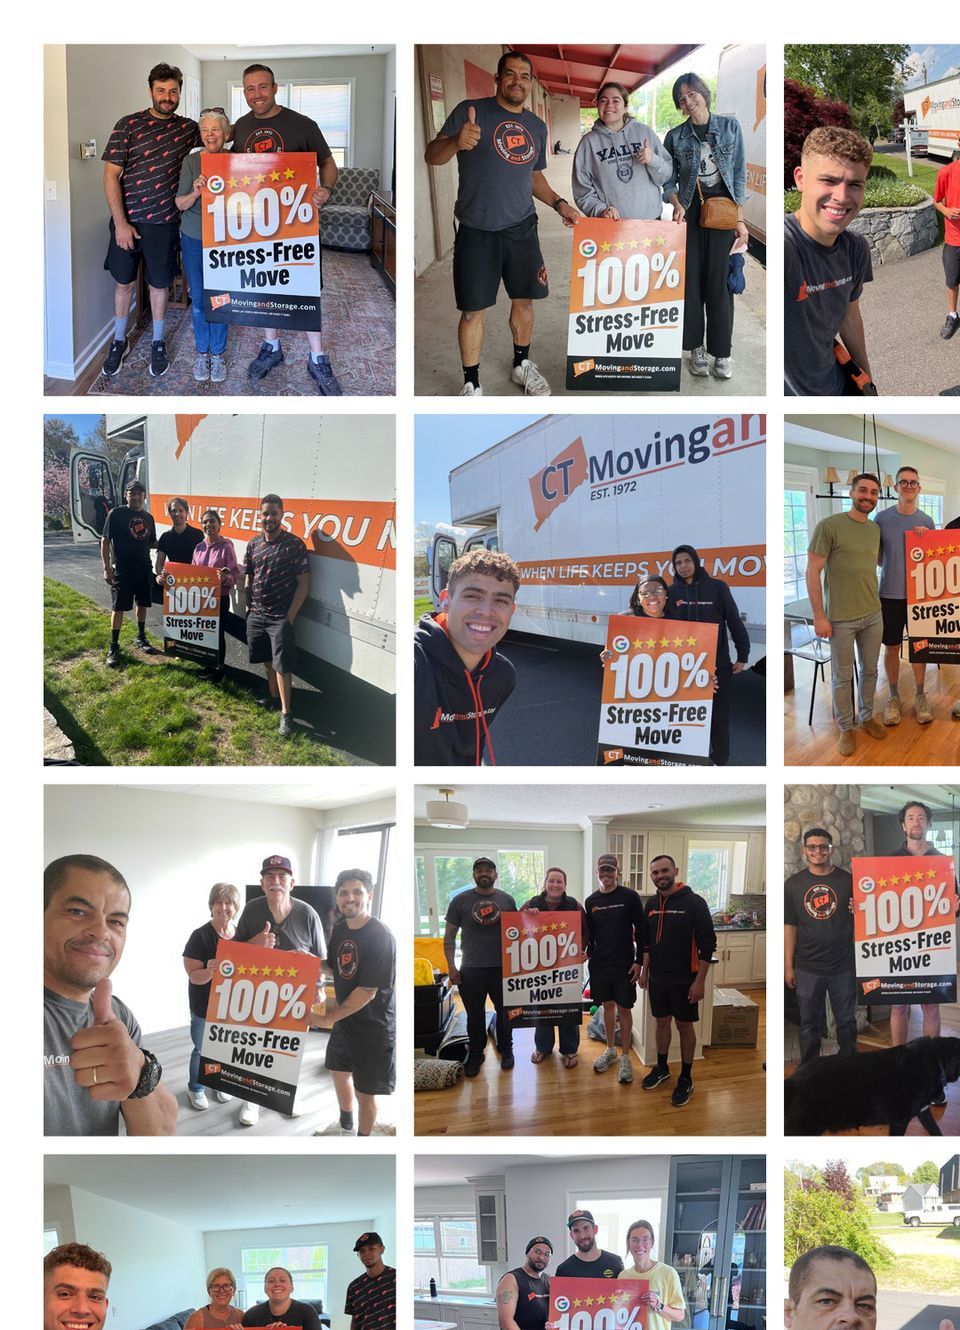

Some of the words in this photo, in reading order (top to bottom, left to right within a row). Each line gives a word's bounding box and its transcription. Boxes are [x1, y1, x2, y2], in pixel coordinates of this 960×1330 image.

[207, 184, 313, 243] 100%
[209, 242, 315, 270] Stress-Free
[240, 268, 290, 289] Move
[577, 251, 681, 308] 100%
[231, 299, 316, 311] MovingandStorage.com
[575, 306, 680, 335] Stress-Free
[594, 364, 677, 374] MovingandStorage.com
[541, 459, 575, 501] CT
[590, 488, 610, 501] EST.
[612, 481, 637, 496] 1972
[229, 507, 295, 536] KEES
[302, 512, 372, 548] YOU
[521, 567, 555, 581] WHEN
[558, 565, 592, 580] LIFE
[592, 562, 651, 580] KEEPS
[165, 586, 217, 614] 100%
[166, 615, 217, 630] Stress-Free
[610, 652, 710, 700] 100%
[606, 705, 708, 725] Stress-Free
[859, 881, 951, 936] 100%
[506, 930, 578, 974] 100%
[861, 930, 952, 960] Stress-Free
[889, 953, 931, 974] Move
[507, 968, 579, 992] Stress-Free
[881, 981, 953, 990] MovingandStorage.com
[215, 978, 308, 1025] 100%
[209, 1024, 301, 1053] Stress-Free
